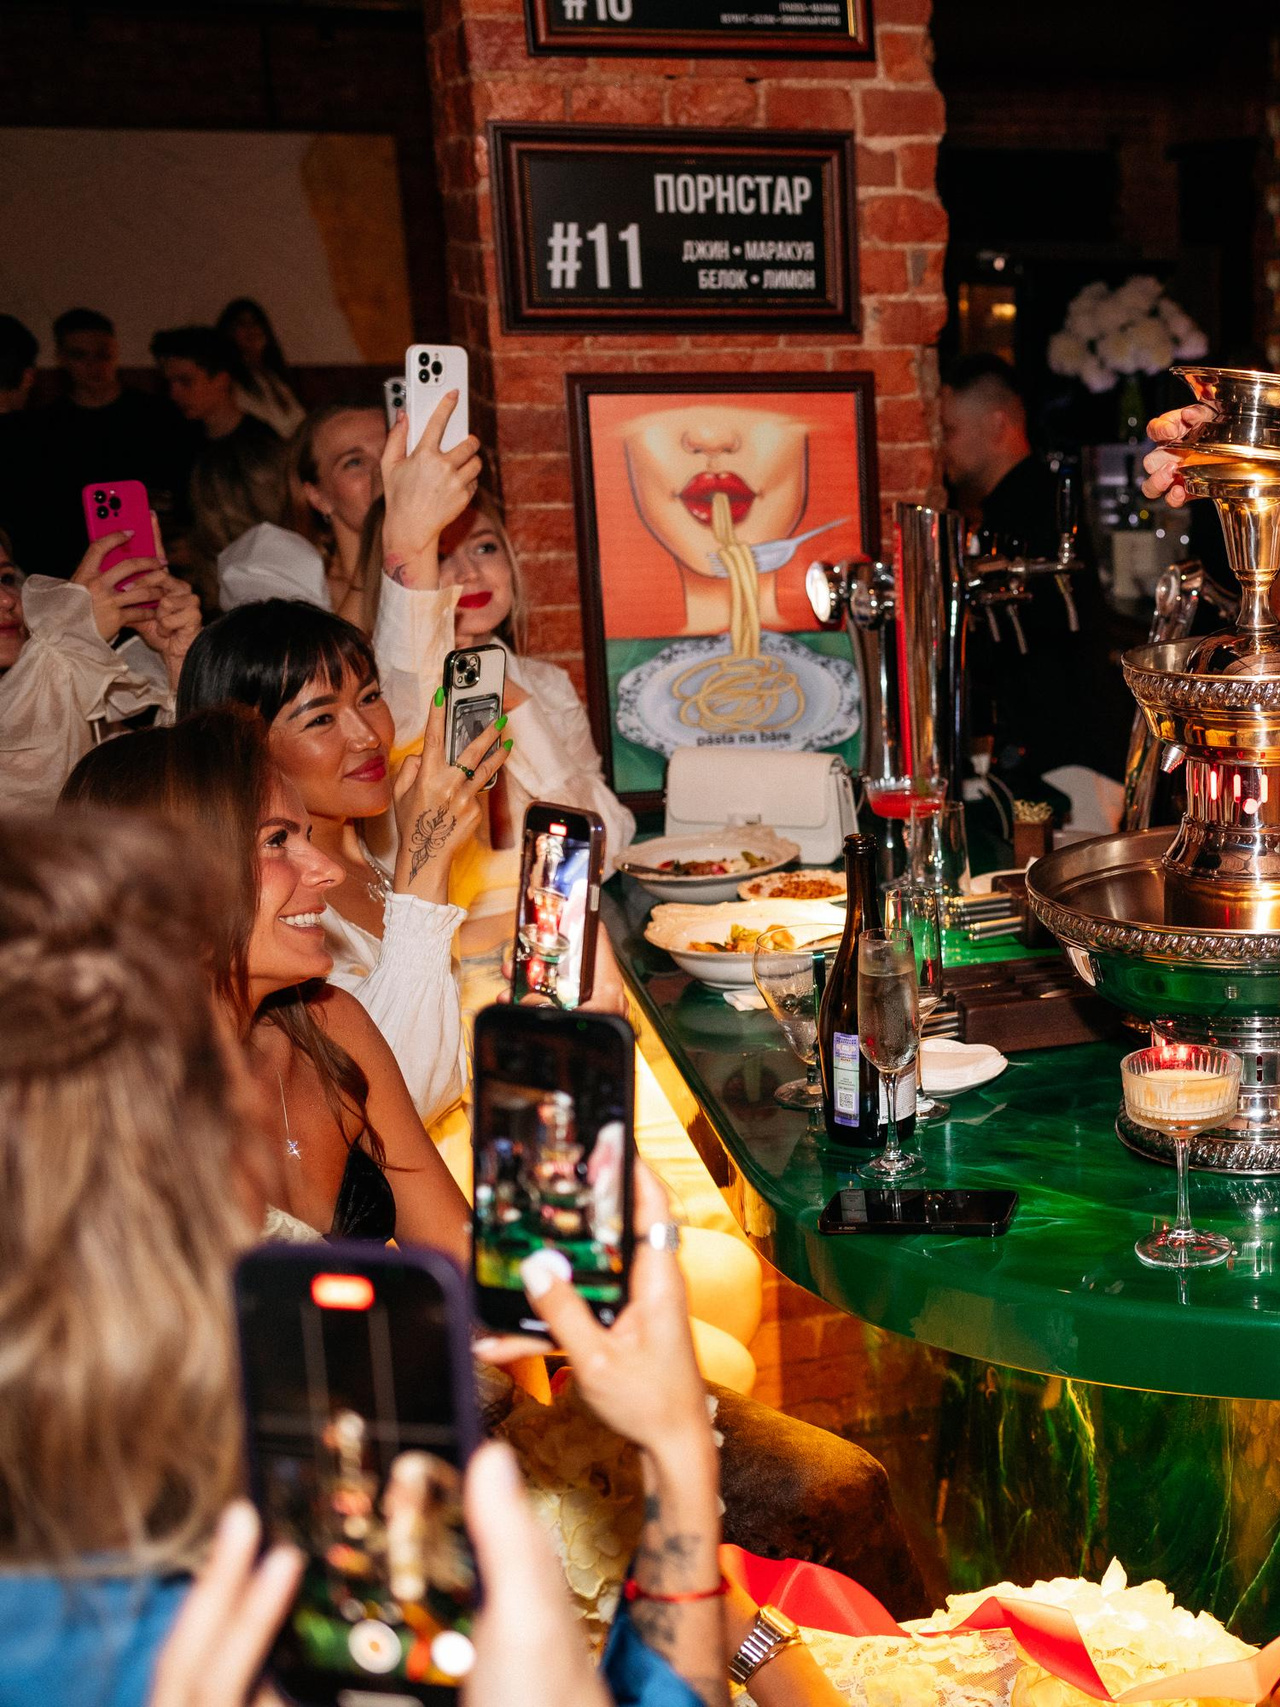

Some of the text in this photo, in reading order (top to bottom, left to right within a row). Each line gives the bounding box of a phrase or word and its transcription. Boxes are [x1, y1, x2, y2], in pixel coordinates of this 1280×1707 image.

[653, 172, 813, 215] ПОРНСТАР
[546, 221, 644, 290] #11
[681, 239, 816, 263] ДЖИН МАРАКУЯ
[697, 268, 817, 291] БЕЛОК ЛИМОН
